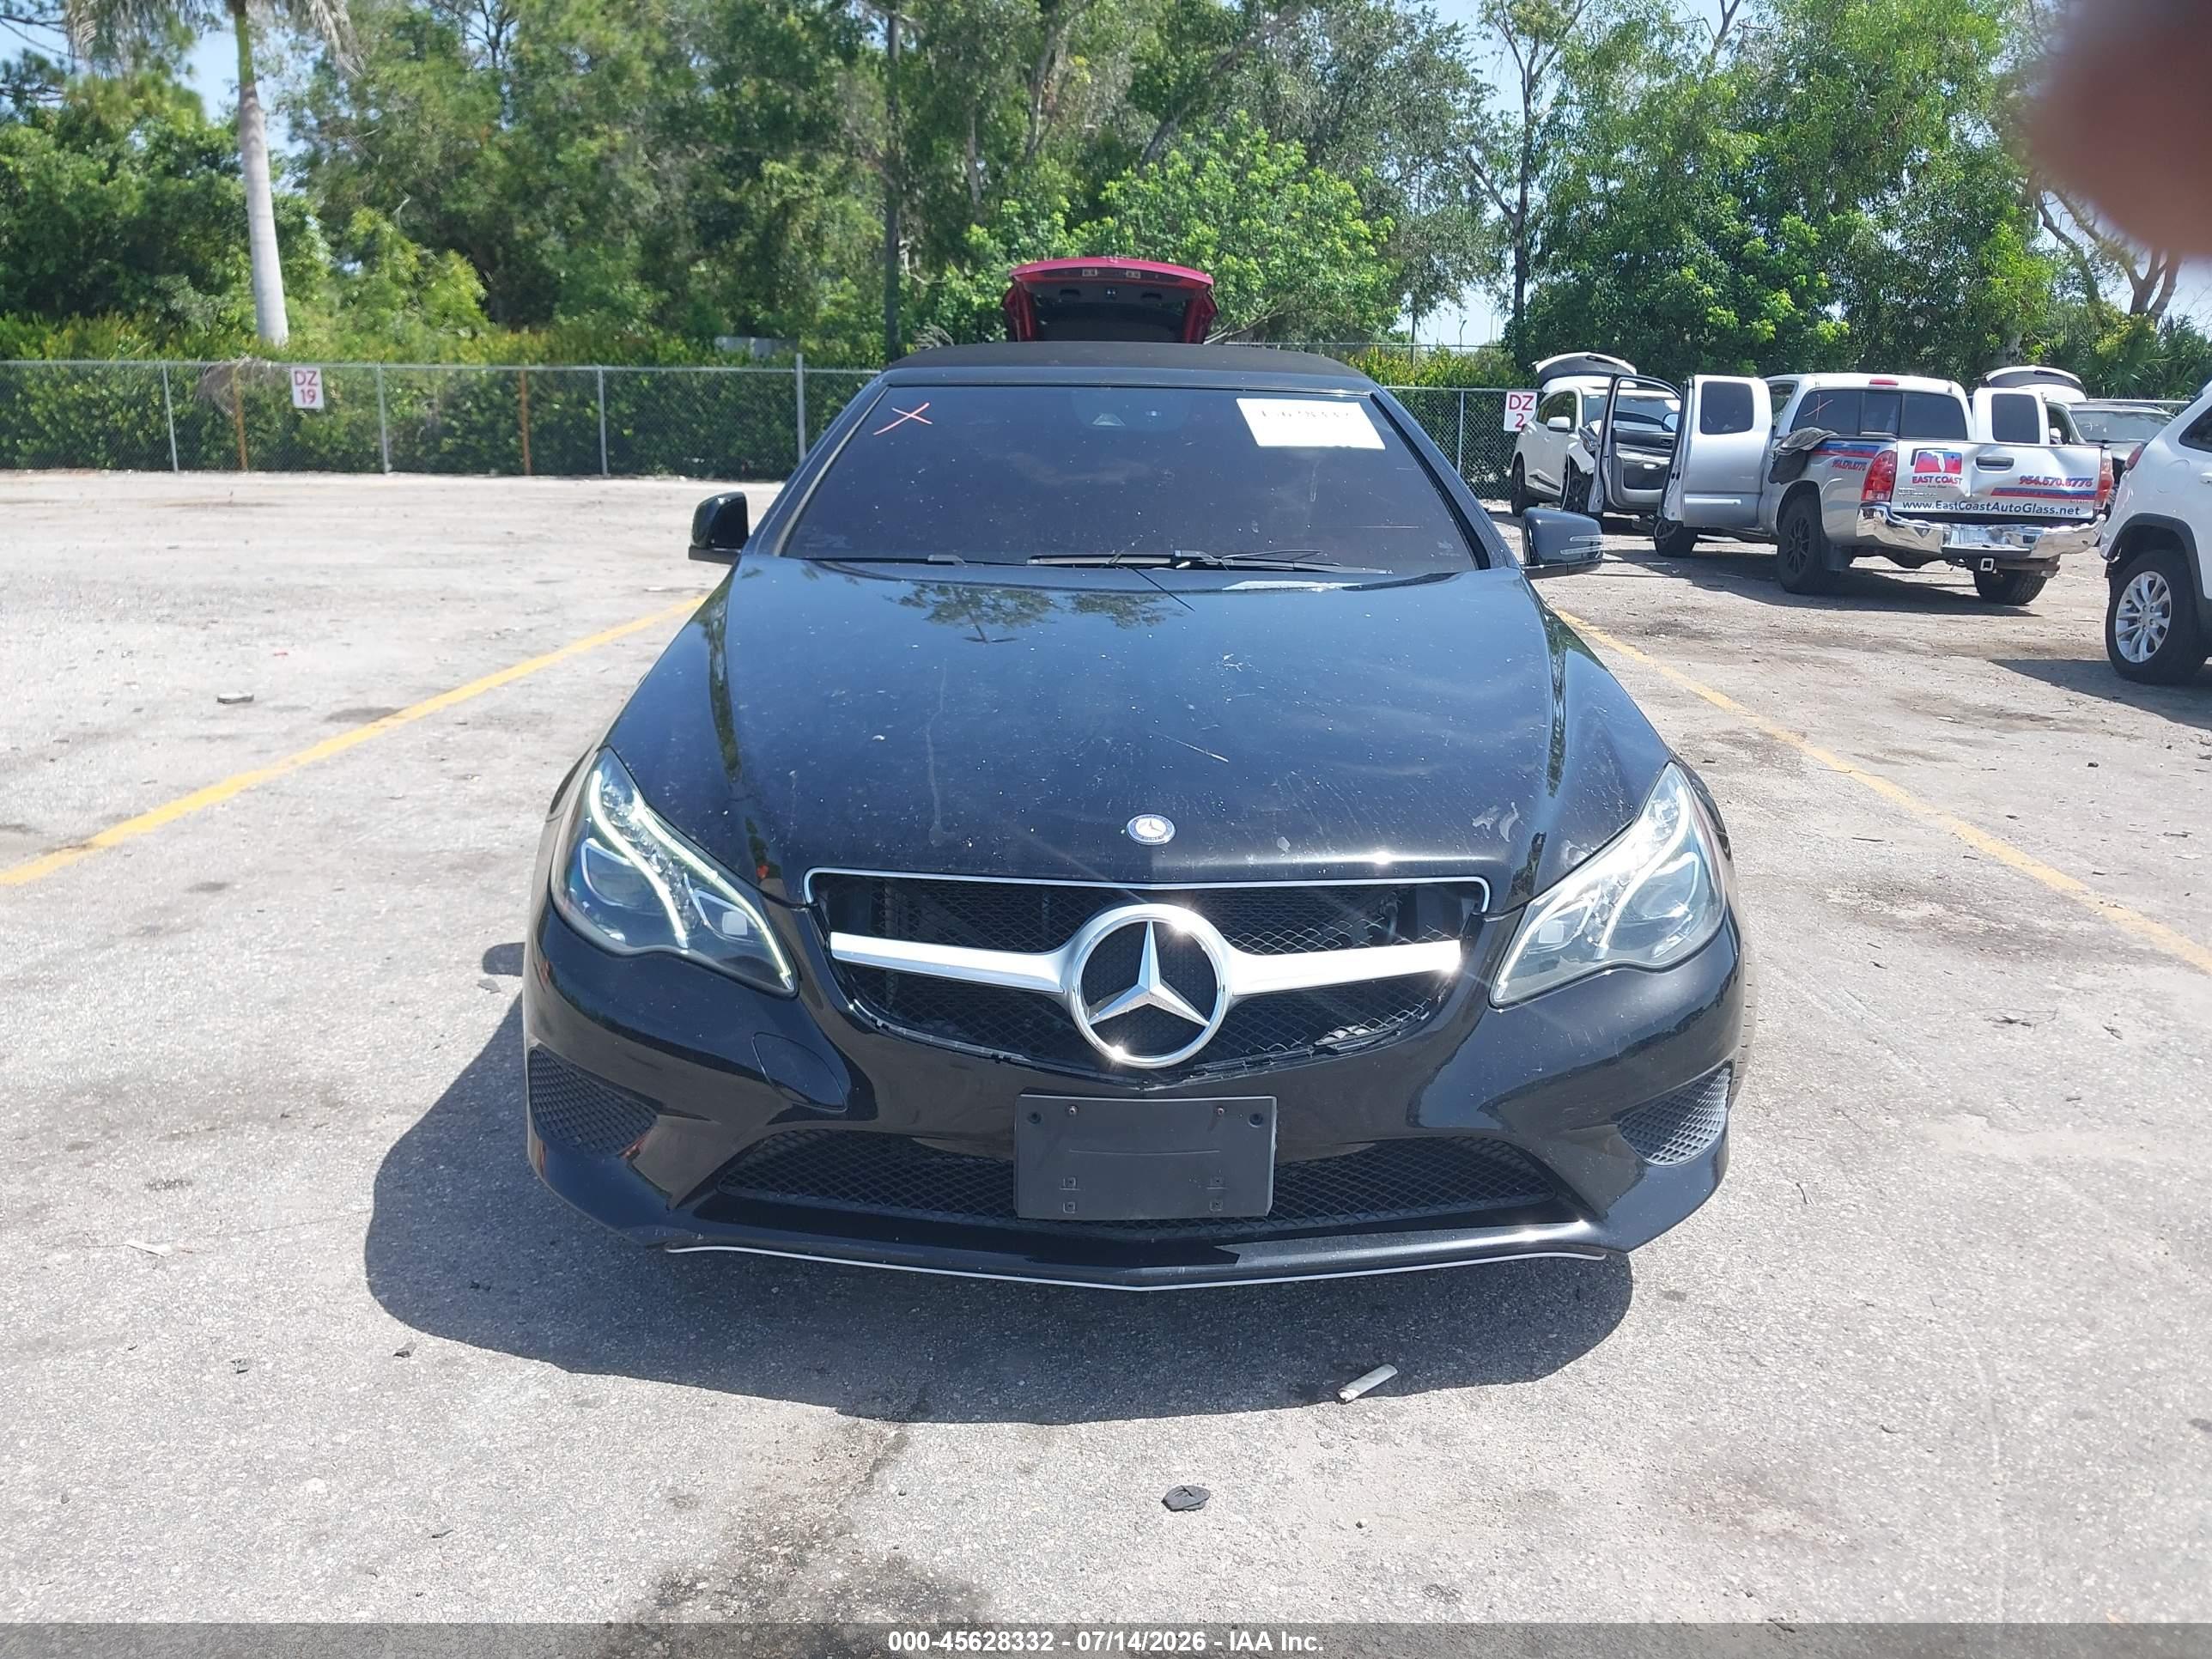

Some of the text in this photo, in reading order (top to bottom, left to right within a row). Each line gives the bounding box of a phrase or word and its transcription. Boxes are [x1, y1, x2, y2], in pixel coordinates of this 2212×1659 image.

[295, 370, 319, 386] DZ
[301, 388, 317, 404] 19
[1508, 394, 1534, 411] DZ
[1515, 413, 1525, 428] 2
[1911, 475, 1963, 485] EAST COAST
[1902, 500, 2081, 515] www.EastCoastAutoGlass.net
